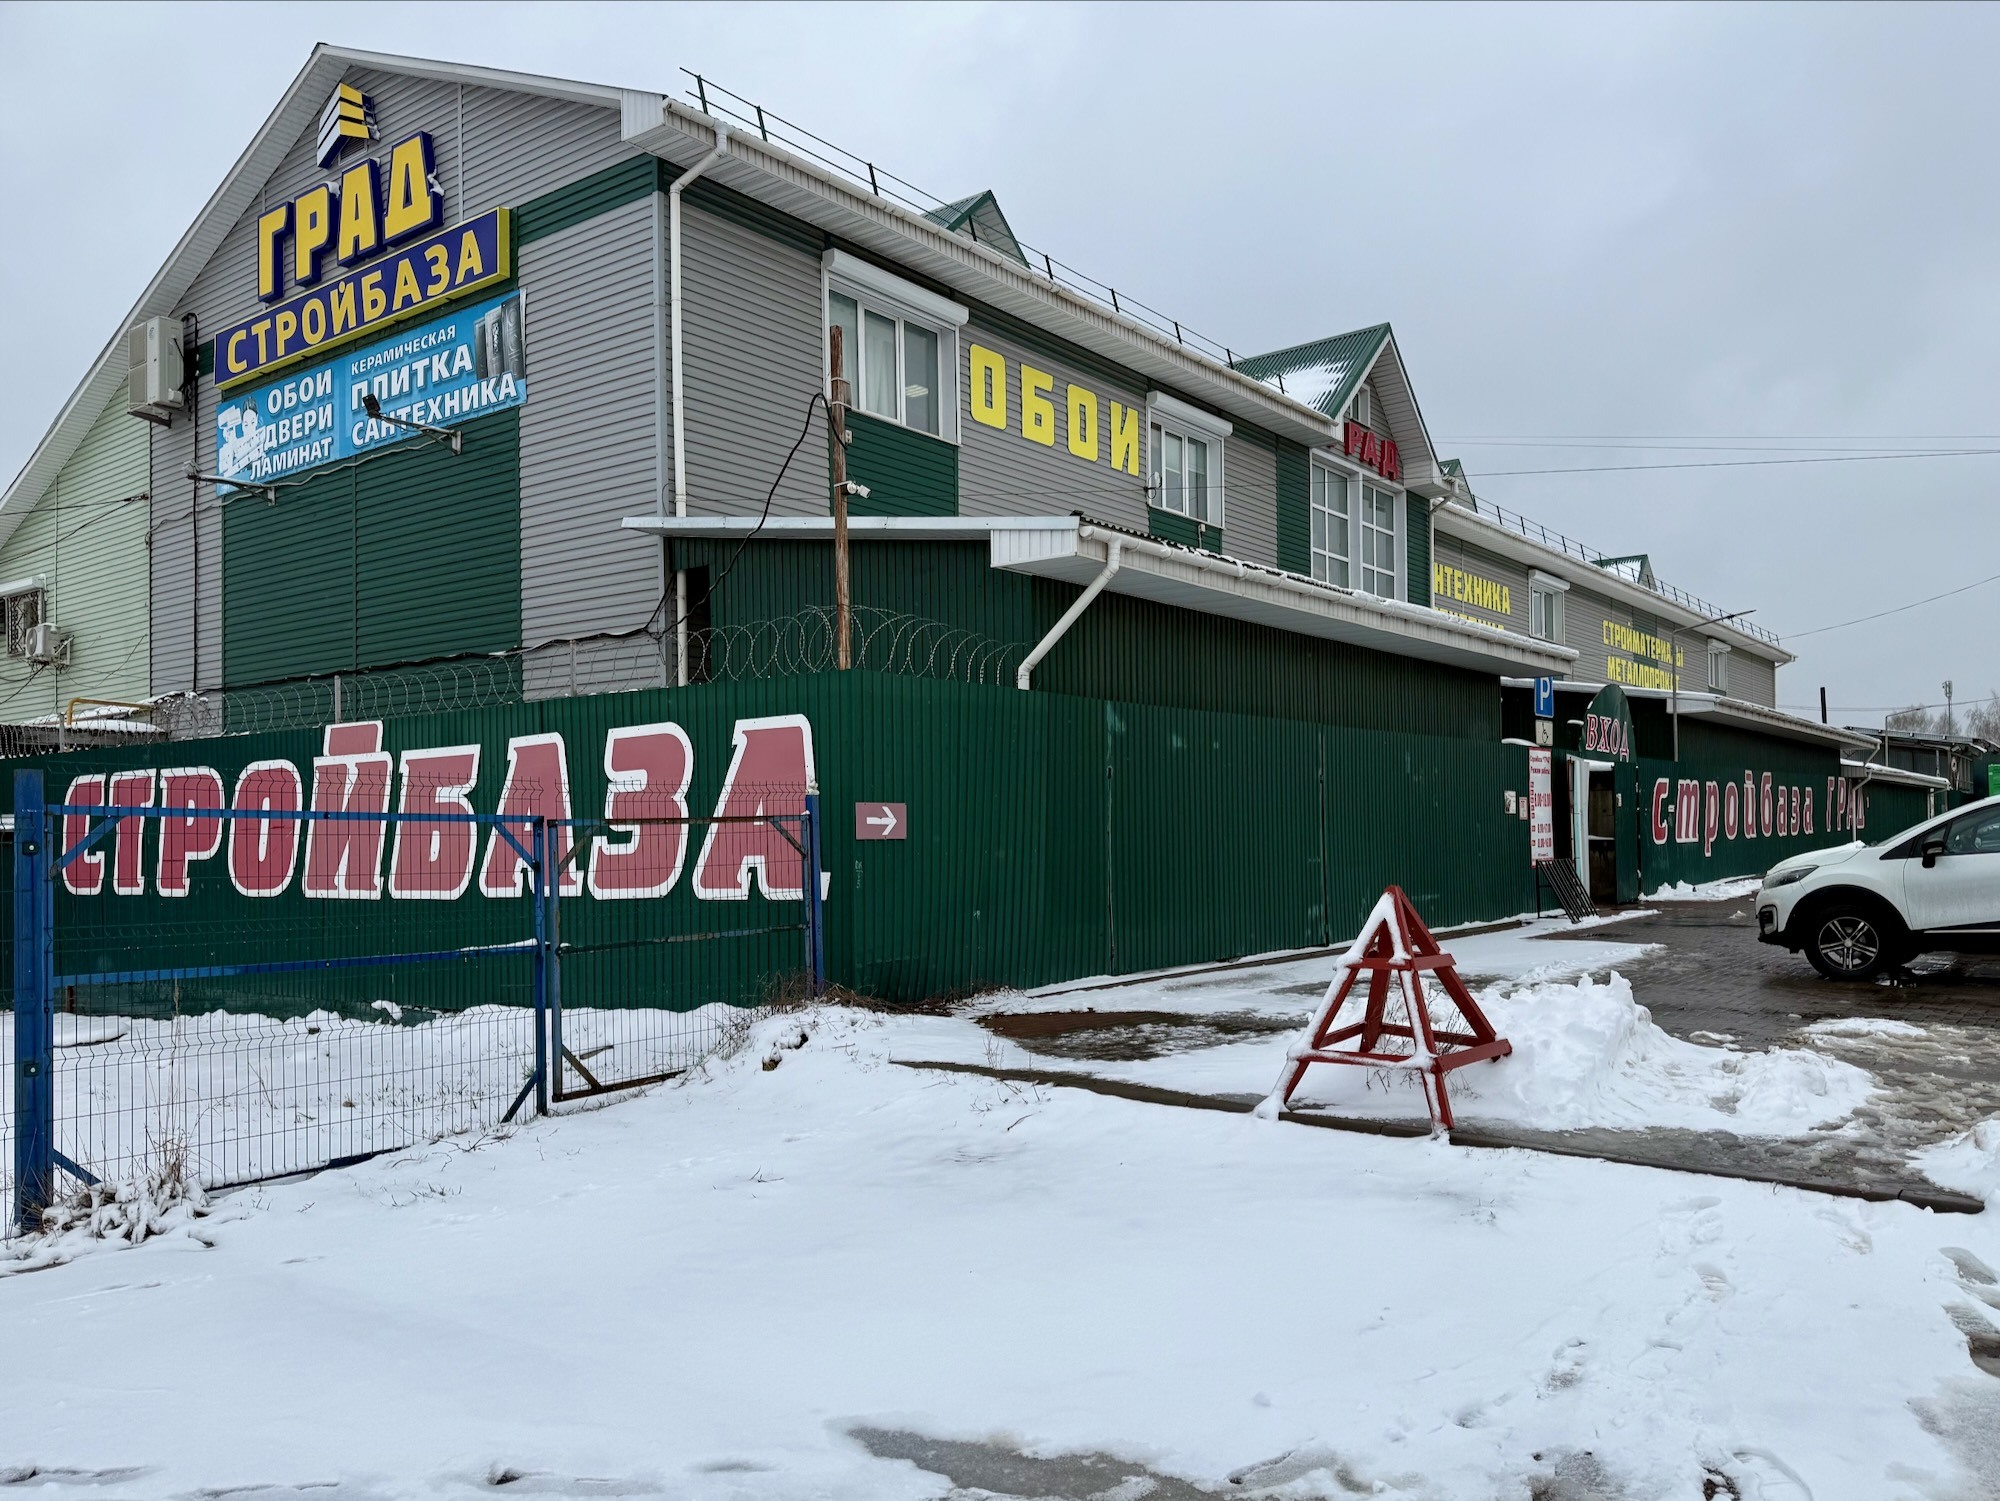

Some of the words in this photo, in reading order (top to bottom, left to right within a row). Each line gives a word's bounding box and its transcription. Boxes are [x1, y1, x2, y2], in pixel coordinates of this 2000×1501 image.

[258, 131, 441, 301] ГРАД
[227, 230, 484, 374] СТРОЙБАЗА
[351, 325, 456, 376] КЕРАМИЧЕСКАЯ
[351, 344, 473, 411] ПЛИТКА
[267, 369, 333, 415] ОБОИ
[352, 372, 518, 447] САНТЕХНИКА
[969, 343, 1140, 477] ОБОИ
[264, 403, 333, 452] ДВЕРИ
[1343, 421, 1399, 481] РАД
[250, 437, 333, 481] ЛАМИНАТ
[1602, 620, 1684, 668] СТРОЙМАТЕРИАЫ
[1586, 714, 1630, 763] ВХОД
[62, 714, 831, 901] СТРОЙБАЗА
